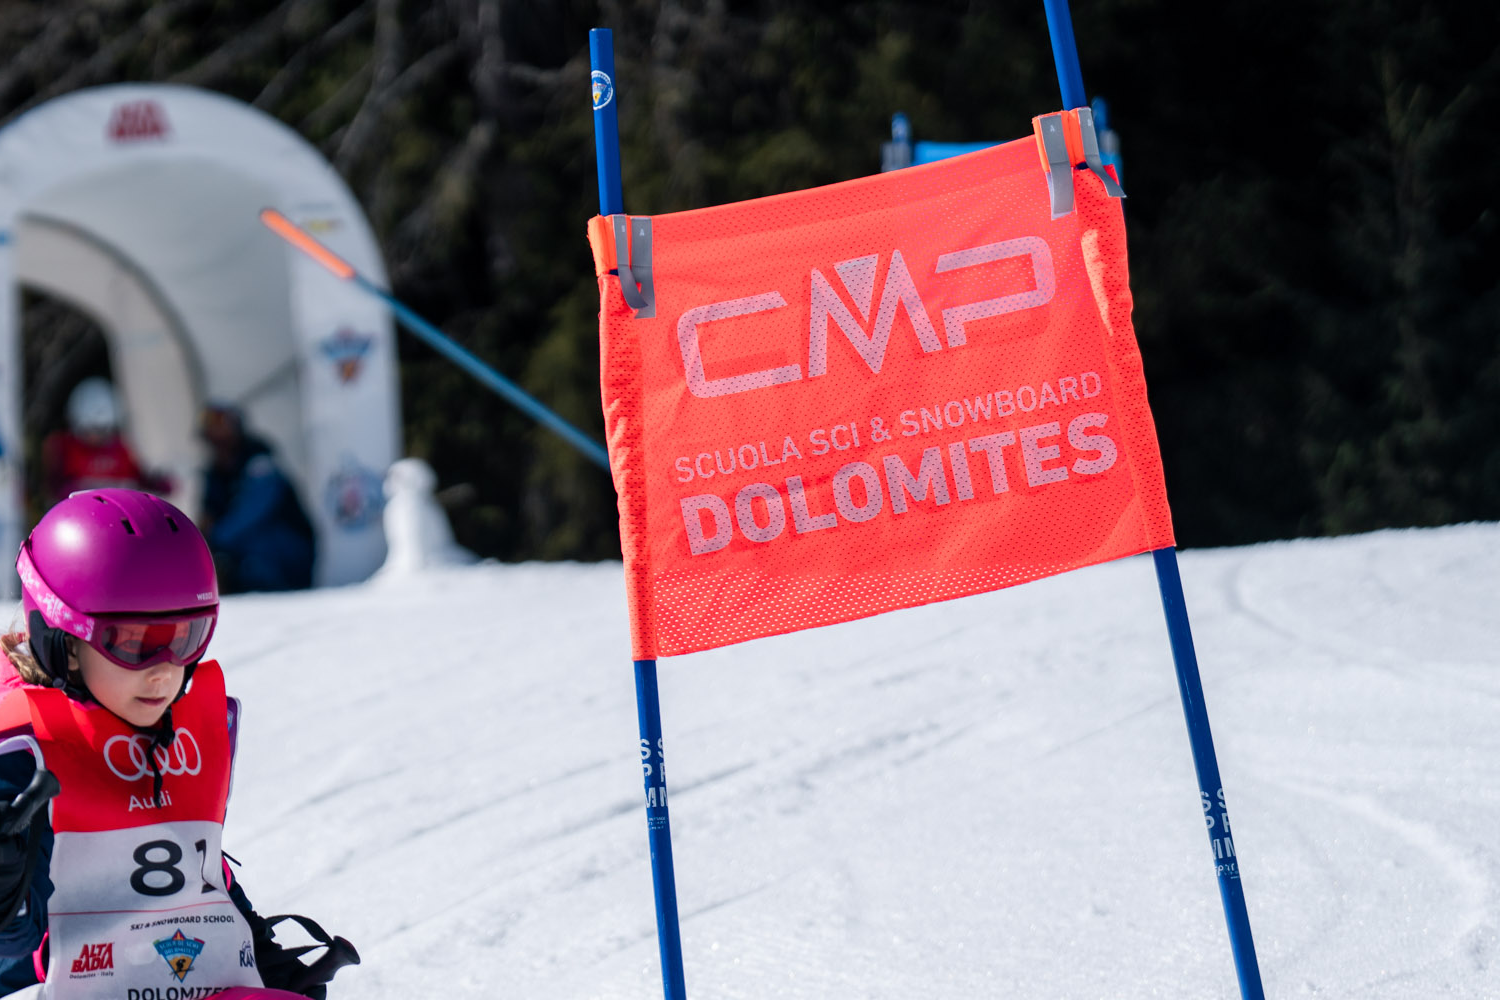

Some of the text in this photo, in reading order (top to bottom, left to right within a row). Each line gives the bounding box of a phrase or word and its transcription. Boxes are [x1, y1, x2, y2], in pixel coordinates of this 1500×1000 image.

[677, 234, 1055, 399] CMP
[674, 370, 1103, 484] SCUOLA SCI & SNOWBOARD
[679, 411, 1119, 557] DOLOMITES
[128, 789, 173, 813] Audi
[130, 838, 218, 897] 81
[130, 923, 145, 931] SKI
[151, 915, 201, 927] SNOWBOARD
[203, 915, 235, 924] SCHOOL
[70, 956, 114, 973] BADIA
[79, 942, 113, 961] ALTA
